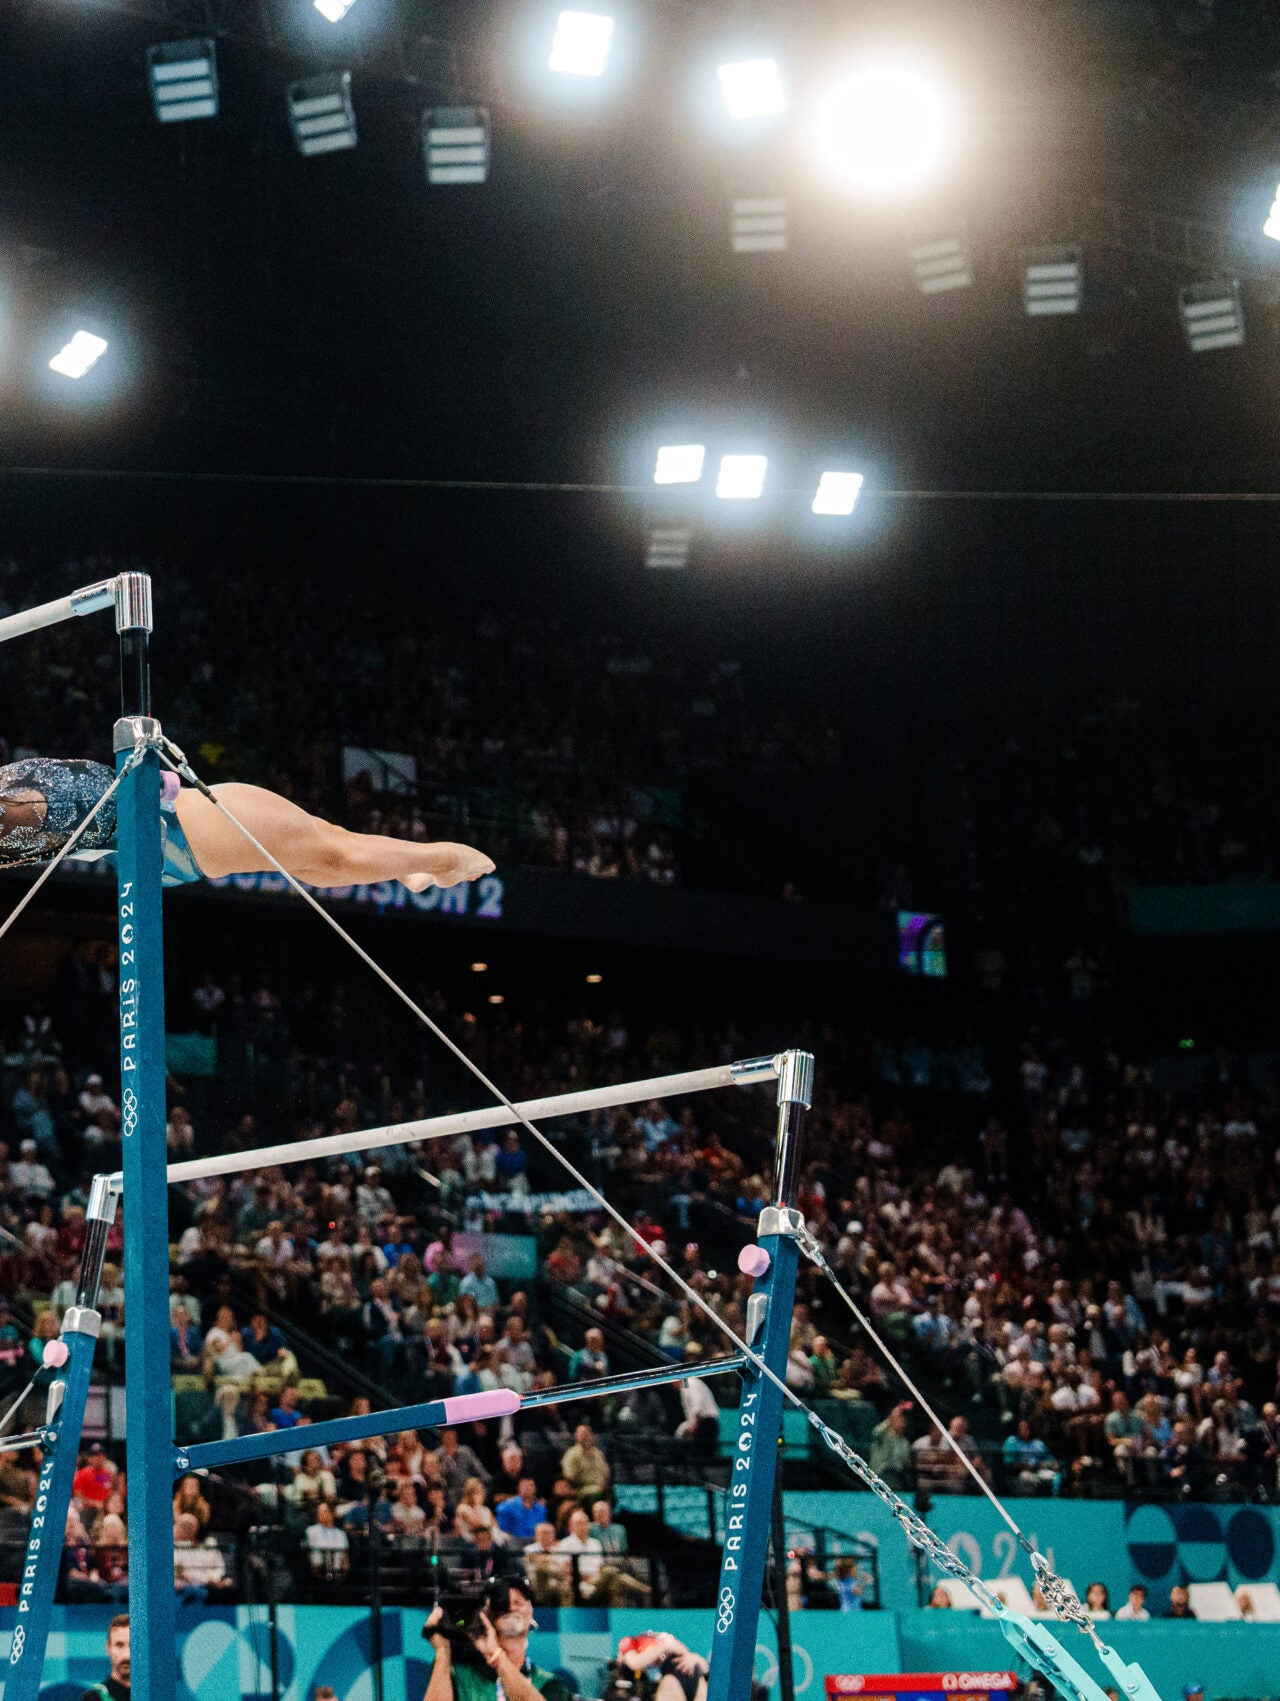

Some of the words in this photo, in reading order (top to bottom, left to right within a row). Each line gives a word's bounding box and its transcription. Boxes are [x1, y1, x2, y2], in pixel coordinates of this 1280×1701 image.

[121, 882, 135, 965] 2024
[478, 877, 504, 918] 2
[735, 1393, 758, 1471] 2024
[33, 1462, 54, 1529] 2024
[958, 1673, 1012, 1690] OMEGA
